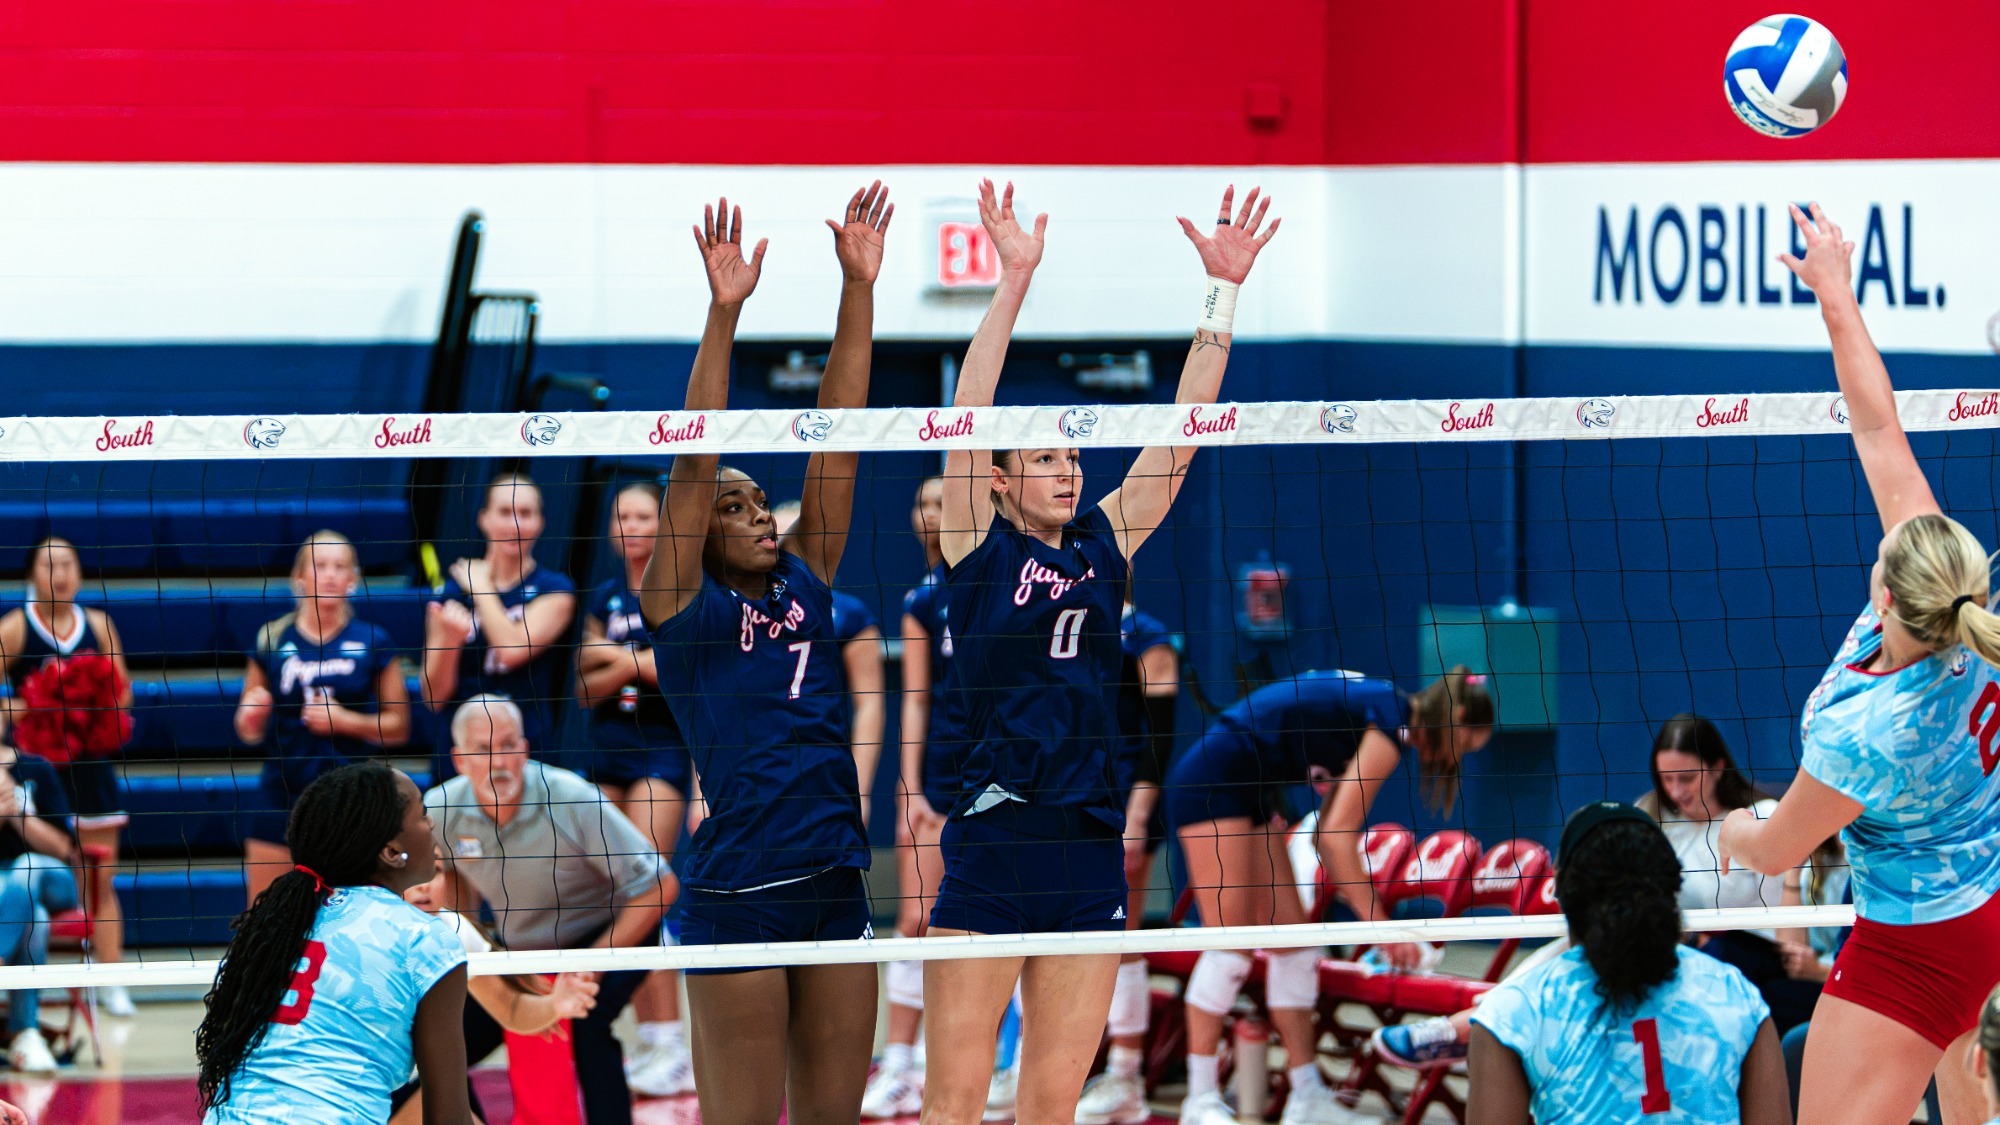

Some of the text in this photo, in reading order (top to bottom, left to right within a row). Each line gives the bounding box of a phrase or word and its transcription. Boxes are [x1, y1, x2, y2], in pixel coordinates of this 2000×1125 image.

[1857, 203, 1947, 307] AL.
[1441, 402, 1495, 433] South
[1696, 398, 1749, 428] South
[1949, 391, 1999, 422] South
[96, 420, 153, 452] South
[374, 417, 433, 449] South
[649, 414, 705, 445] South
[919, 411, 974, 442] South
[1183, 407, 1238, 438] South
[1050, 608, 1087, 659] 0
[788, 641, 811, 700] 7
[1632, 1017, 1671, 1115] 1
